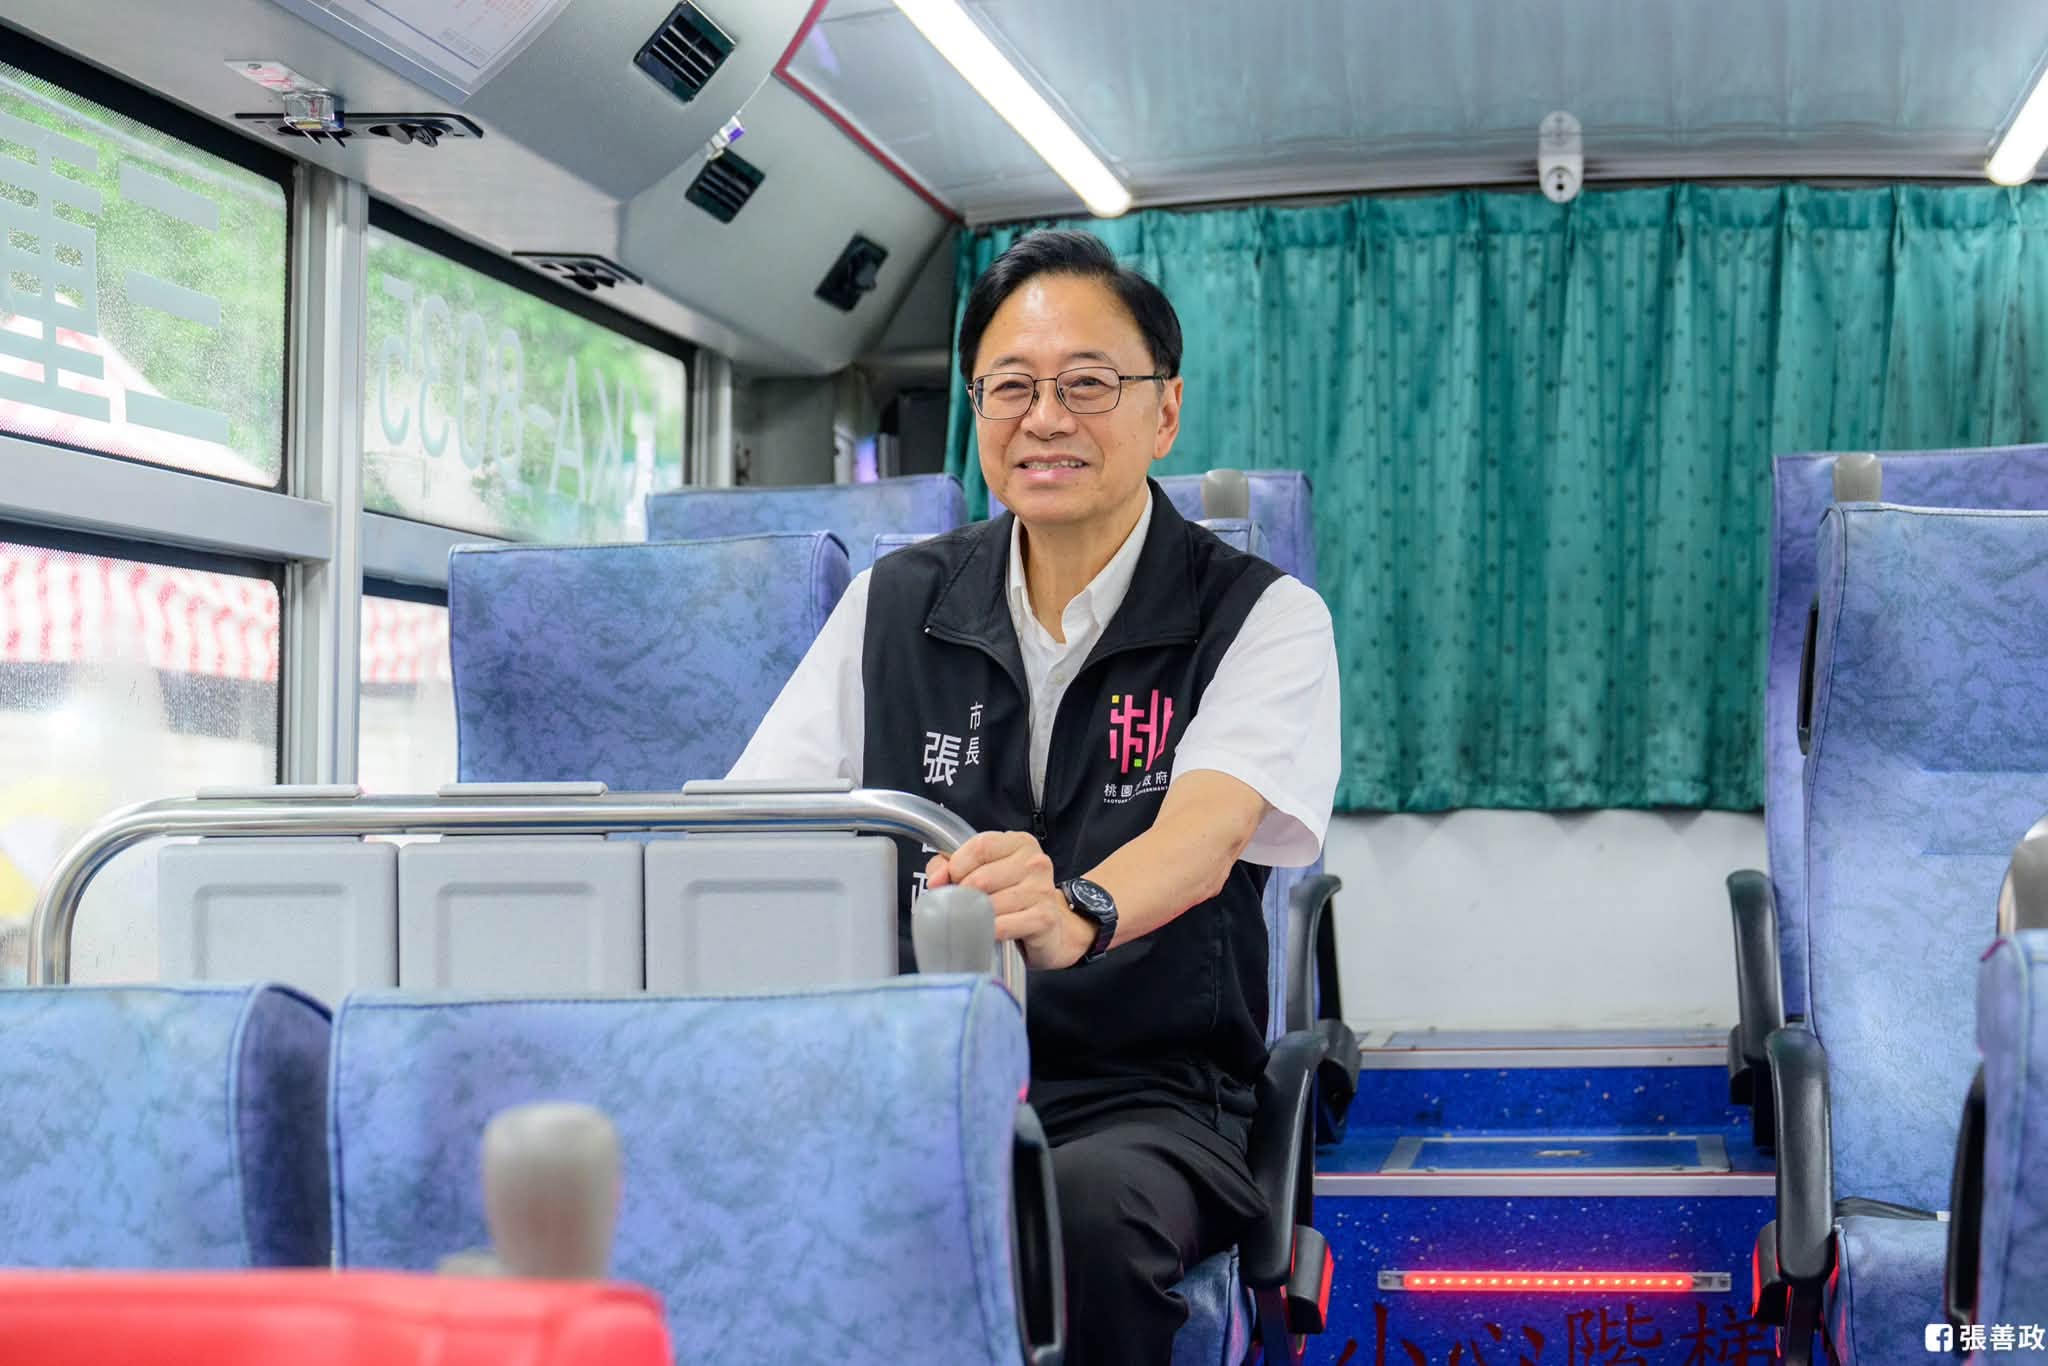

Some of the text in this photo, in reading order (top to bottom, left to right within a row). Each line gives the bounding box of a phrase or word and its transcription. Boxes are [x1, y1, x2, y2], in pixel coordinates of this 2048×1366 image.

[965, 702, 983, 766] 市長
[1103, 771, 1168, 797] 桃園政府
